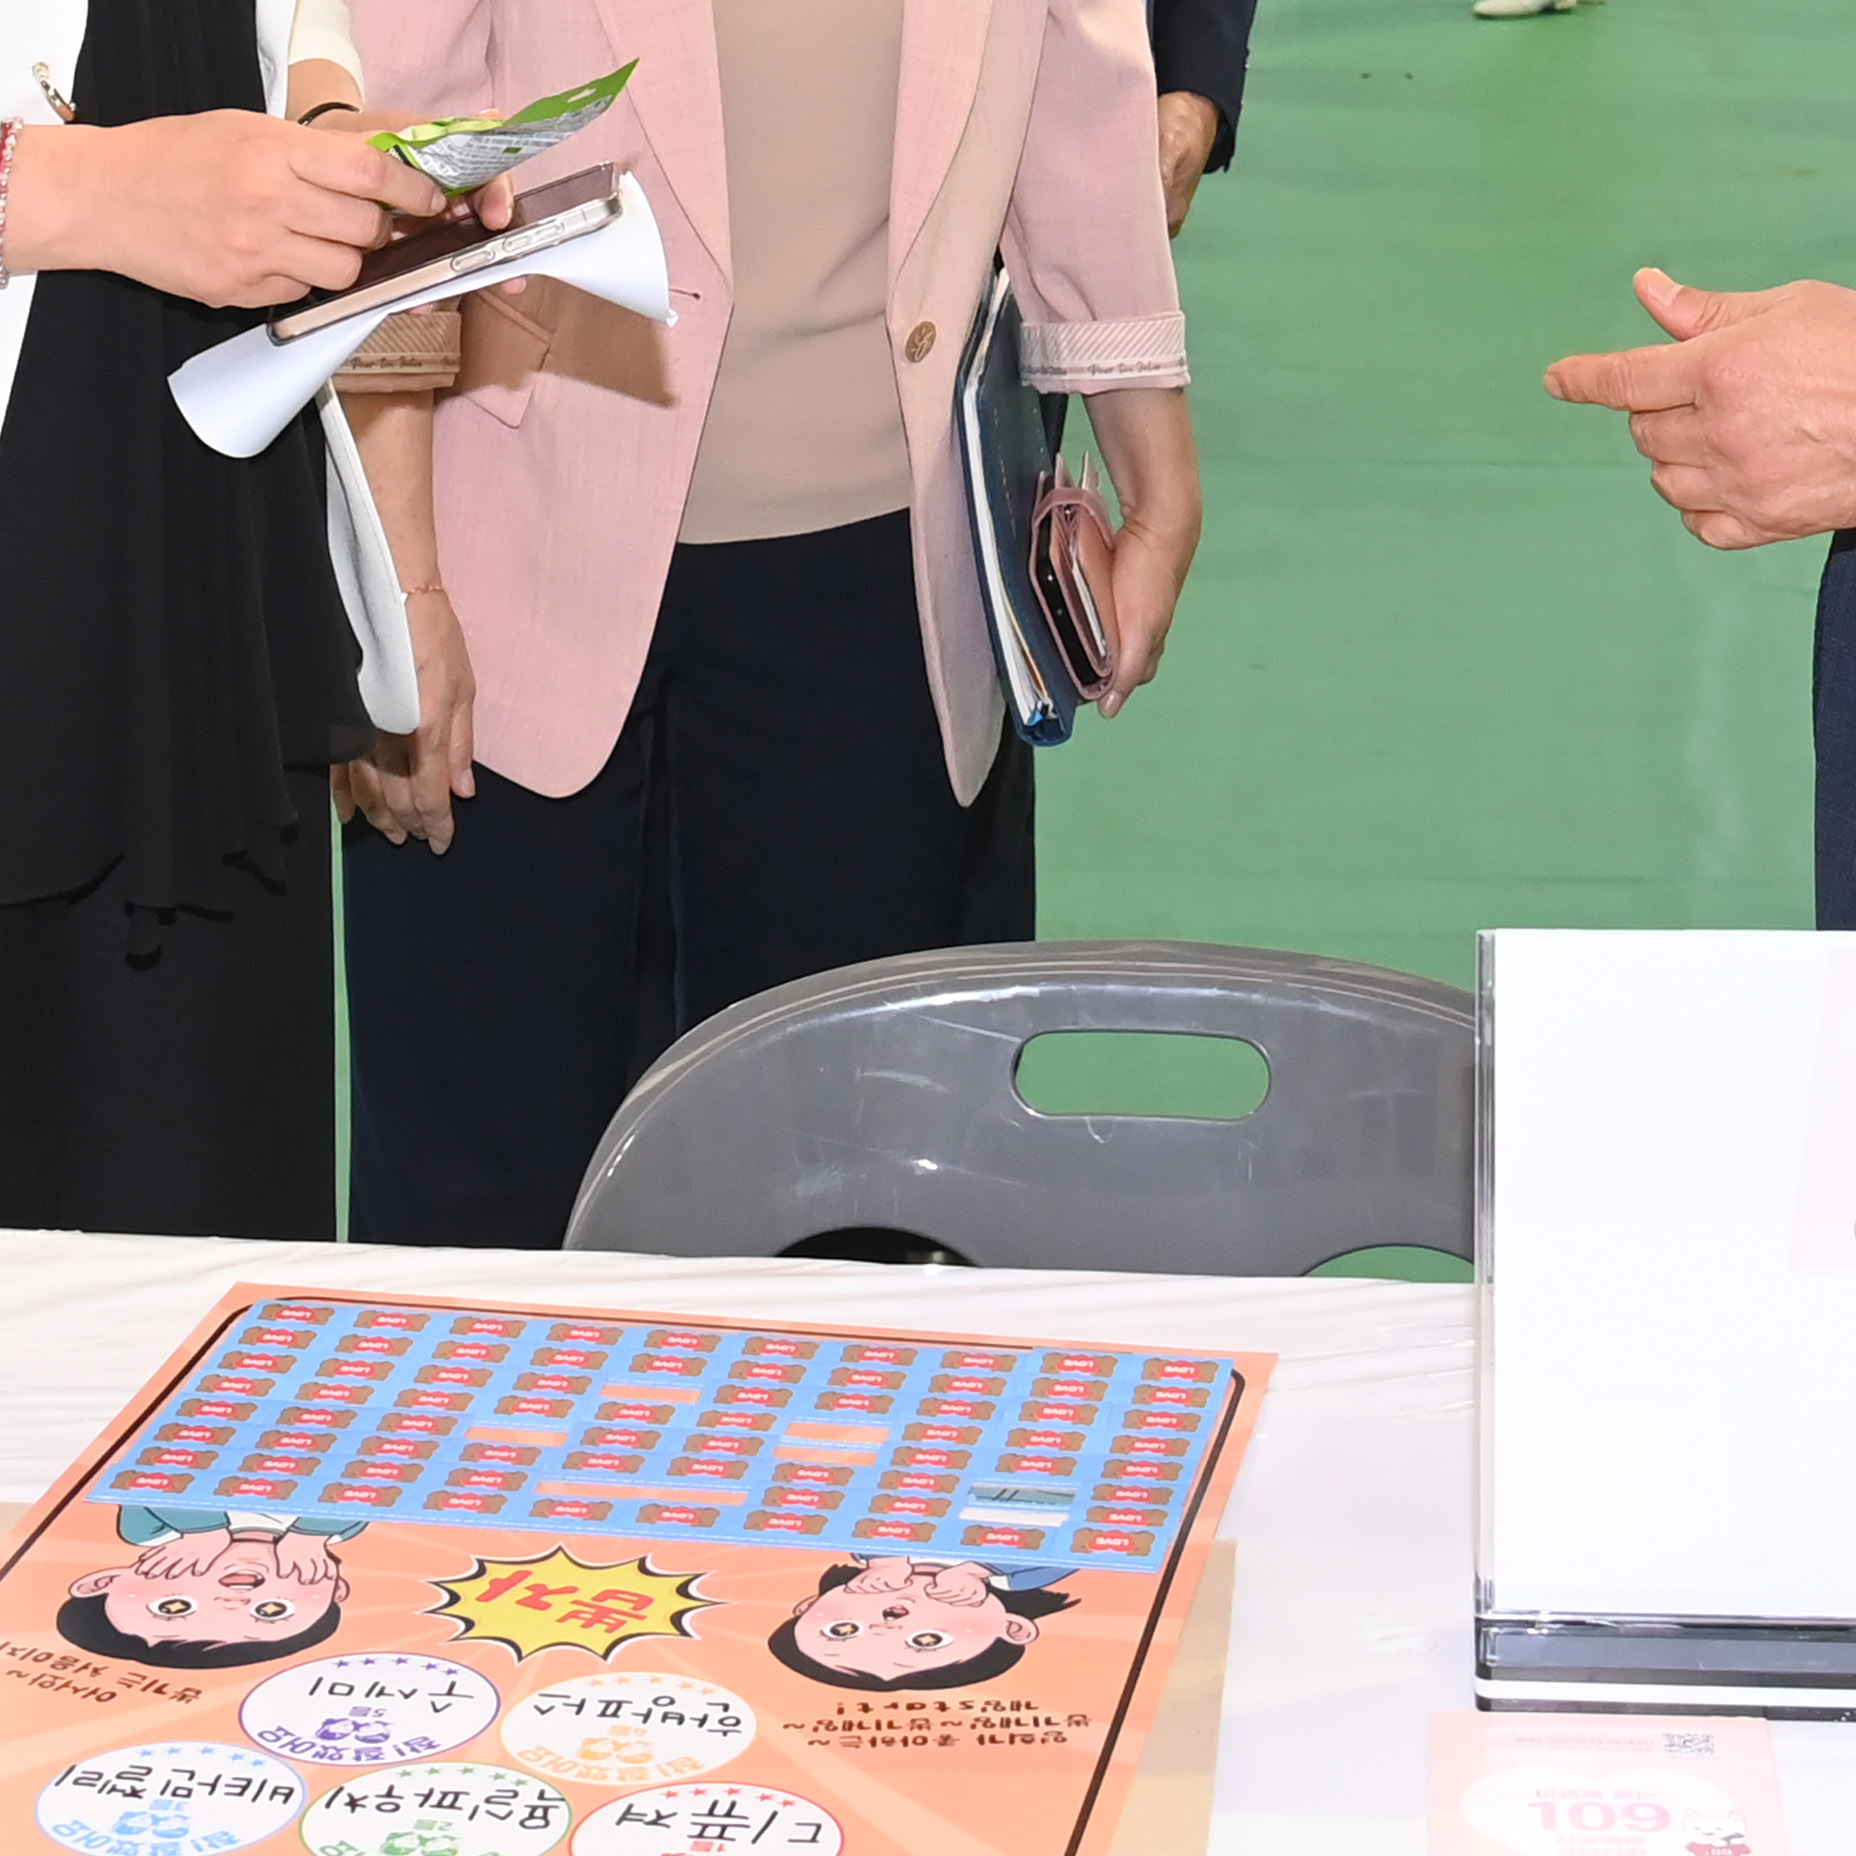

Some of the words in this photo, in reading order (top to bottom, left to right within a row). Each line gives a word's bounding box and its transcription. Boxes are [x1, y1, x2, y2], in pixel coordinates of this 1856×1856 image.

[281, 1309, 313, 1318] LOVE
[261, 1333, 293, 1342] LOVE
[455, 1347, 487, 1356] LOVE
[963, 1356, 995, 1365] LOVE
[1163, 1365, 1195, 1374] LOVE
[536, 1378, 568, 1387] LOVE
[318, 1388, 350, 1397] LOVE
[838, 1397, 870, 1406] LOVE
[619, 1408, 651, 1417] LOVE
[1145, 1415, 1177, 1424] LOVE
[926, 1429, 958, 1438] LOVE
[707, 1439, 739, 1448] LOVE
[915, 1453, 947, 1462] LOVE
[1020, 1460, 1052, 1469] LOVE
[797, 1469, 829, 1478] LOVE
[240, 1483, 272, 1492] LOVE
[449, 1497, 481, 1506] LOVE
[1110, 1513, 1142, 1522] LOVE
[1097, 1537, 1129, 1546] LOVE
[474, 1569, 656, 1634] 뽑자
[307, 1676, 475, 1714] 수세미
[532, 1692, 743, 1737] 한방파스
[323, 1783, 568, 1831] 욕실파우치
[1527, 1800, 1672, 1833] 109
[614, 1798, 825, 1845] 디퓨져
